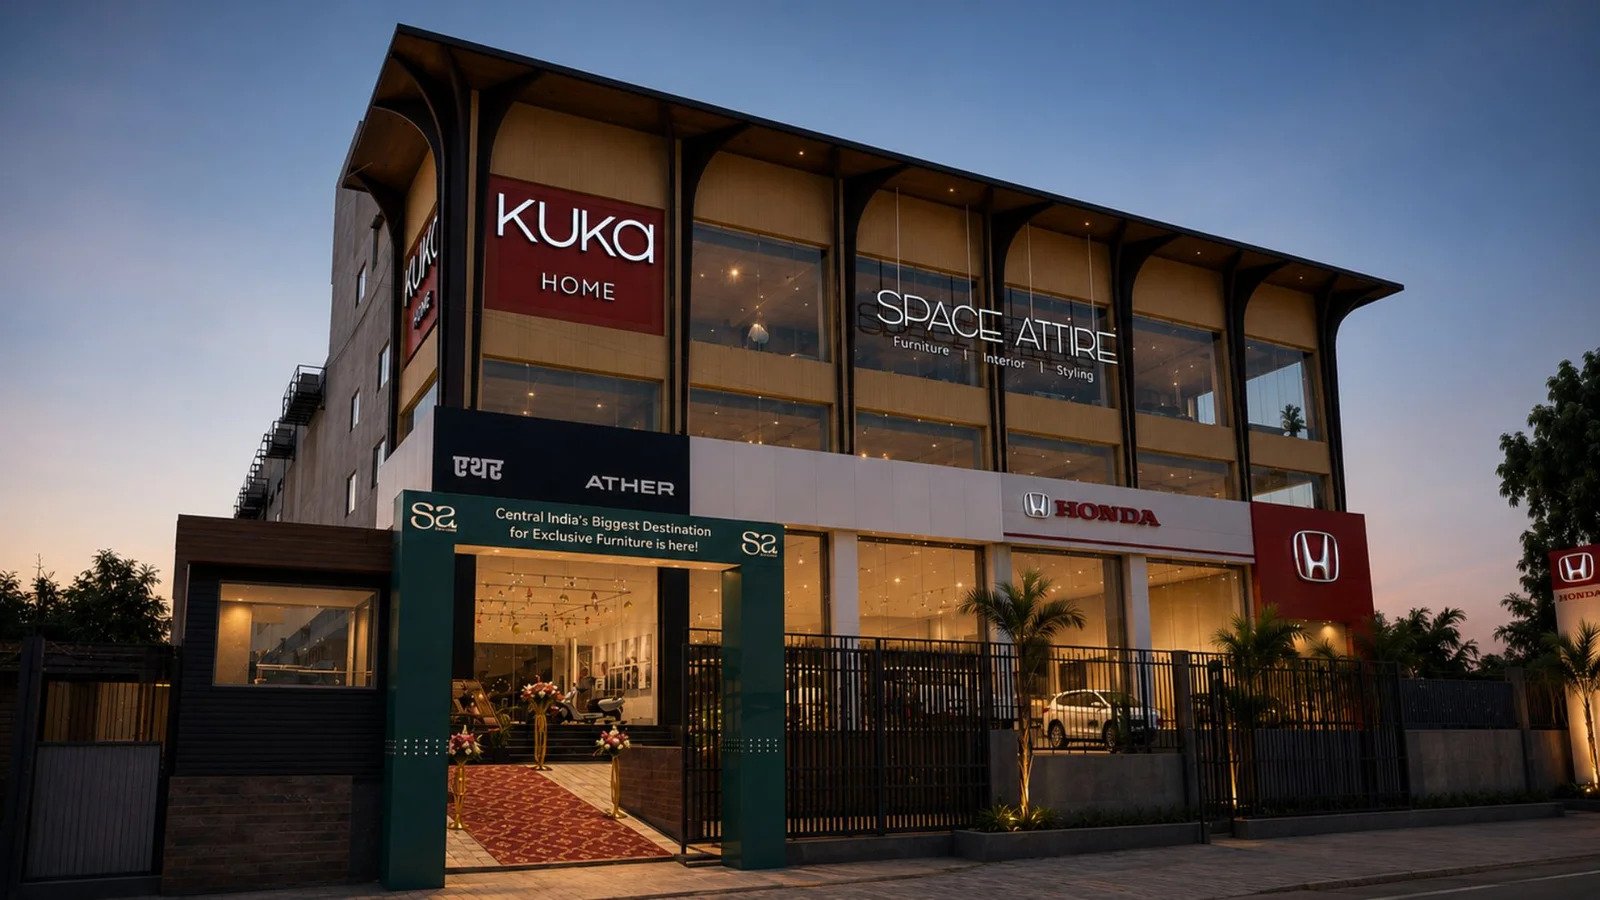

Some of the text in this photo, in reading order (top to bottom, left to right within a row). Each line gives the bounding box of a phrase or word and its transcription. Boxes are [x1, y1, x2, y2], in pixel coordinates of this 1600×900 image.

[542, 272, 616, 301] HOME
[876, 289, 1118, 364] SPACE ATTIRE
[893, 335, 1094, 383] Furniture Interior Styling
[585, 475, 675, 496] ATHER
[495, 507, 712, 537] Central India's Biggest Destination
[1055, 499, 1161, 527] HONDA
[509, 526, 698, 552] for Exclusive Furniture is here!
